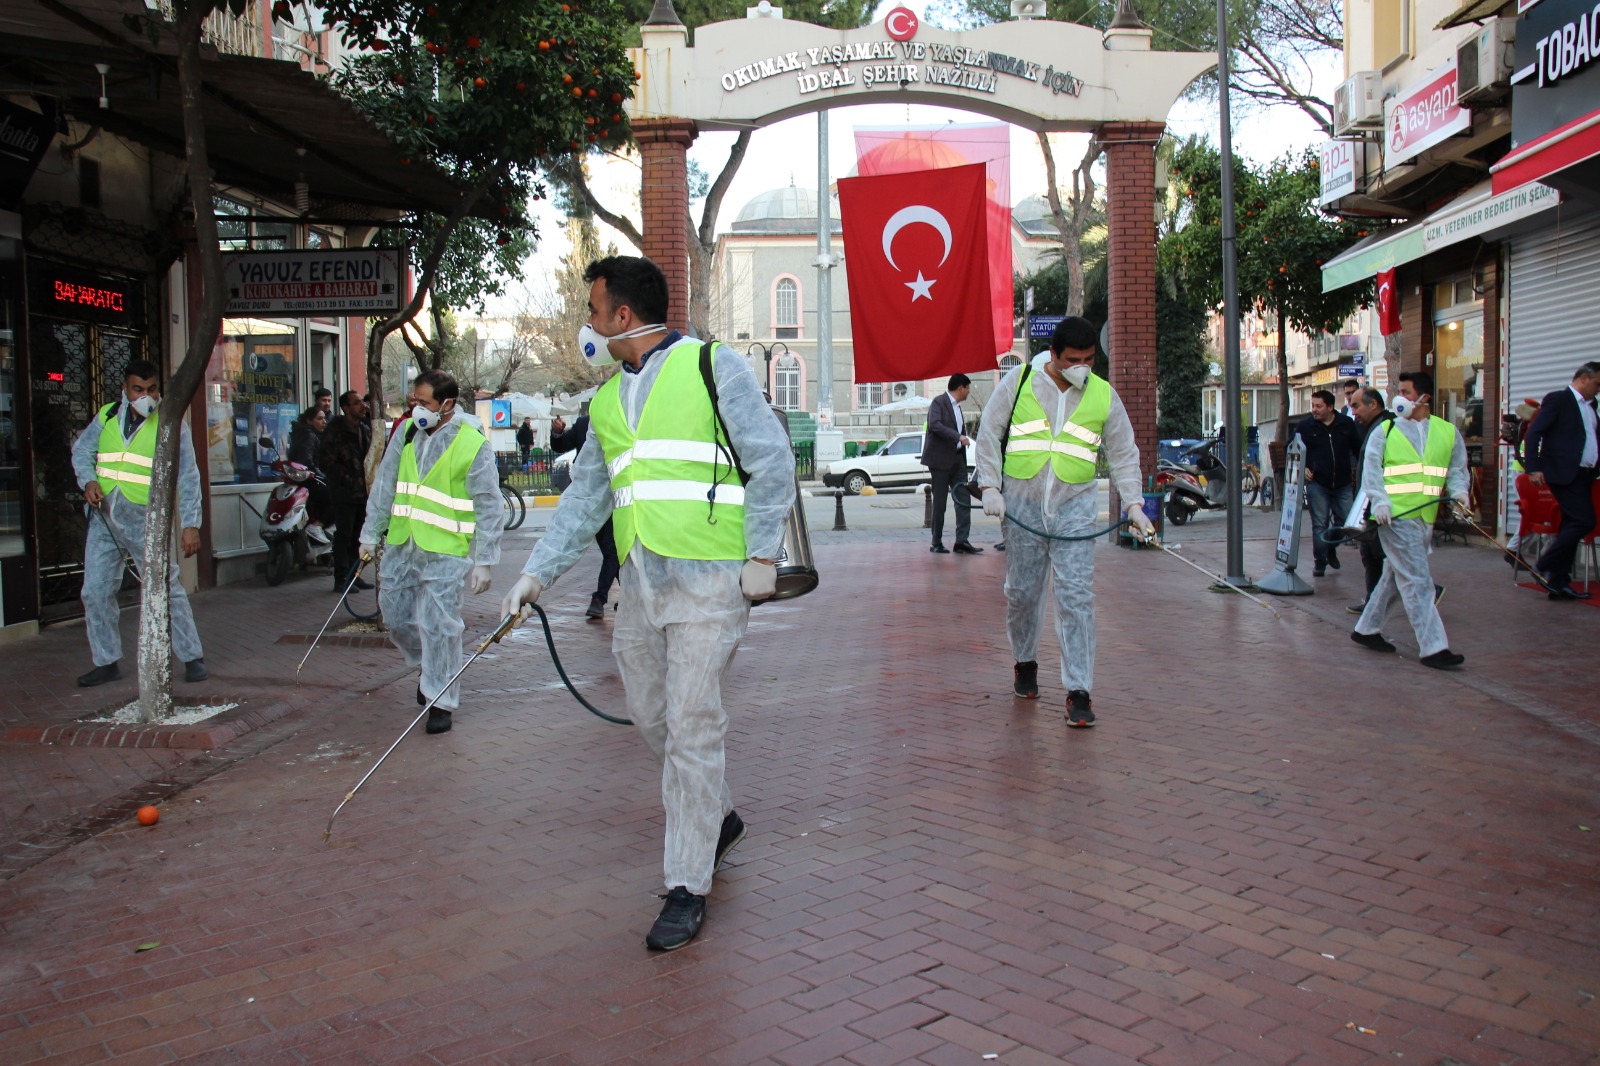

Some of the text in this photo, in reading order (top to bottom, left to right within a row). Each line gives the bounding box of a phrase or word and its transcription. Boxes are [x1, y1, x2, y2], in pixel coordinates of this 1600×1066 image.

[721, 41, 1085, 98] OKUMAK, YAŞAMAK VE YAŞLANMAK İÇİN
[797, 61, 999, 94] İDEAL ŞEHİR NAZİLLİ
[1426, 226, 1443, 242] UZM.
[1444, 210, 1483, 236] VETERİNER
[1484, 190, 1527, 222] BEDRETTİN
[239, 260, 303, 283] YAVUZ
[309, 255, 381, 282] EFENDİ
[245, 281, 376, 299] KURUKAHVE & BAHARAT
[228, 301, 250, 310] YAVUZ
[252, 301, 271, 309] DURU
[1031, 322, 1056, 331] ATATÜR
